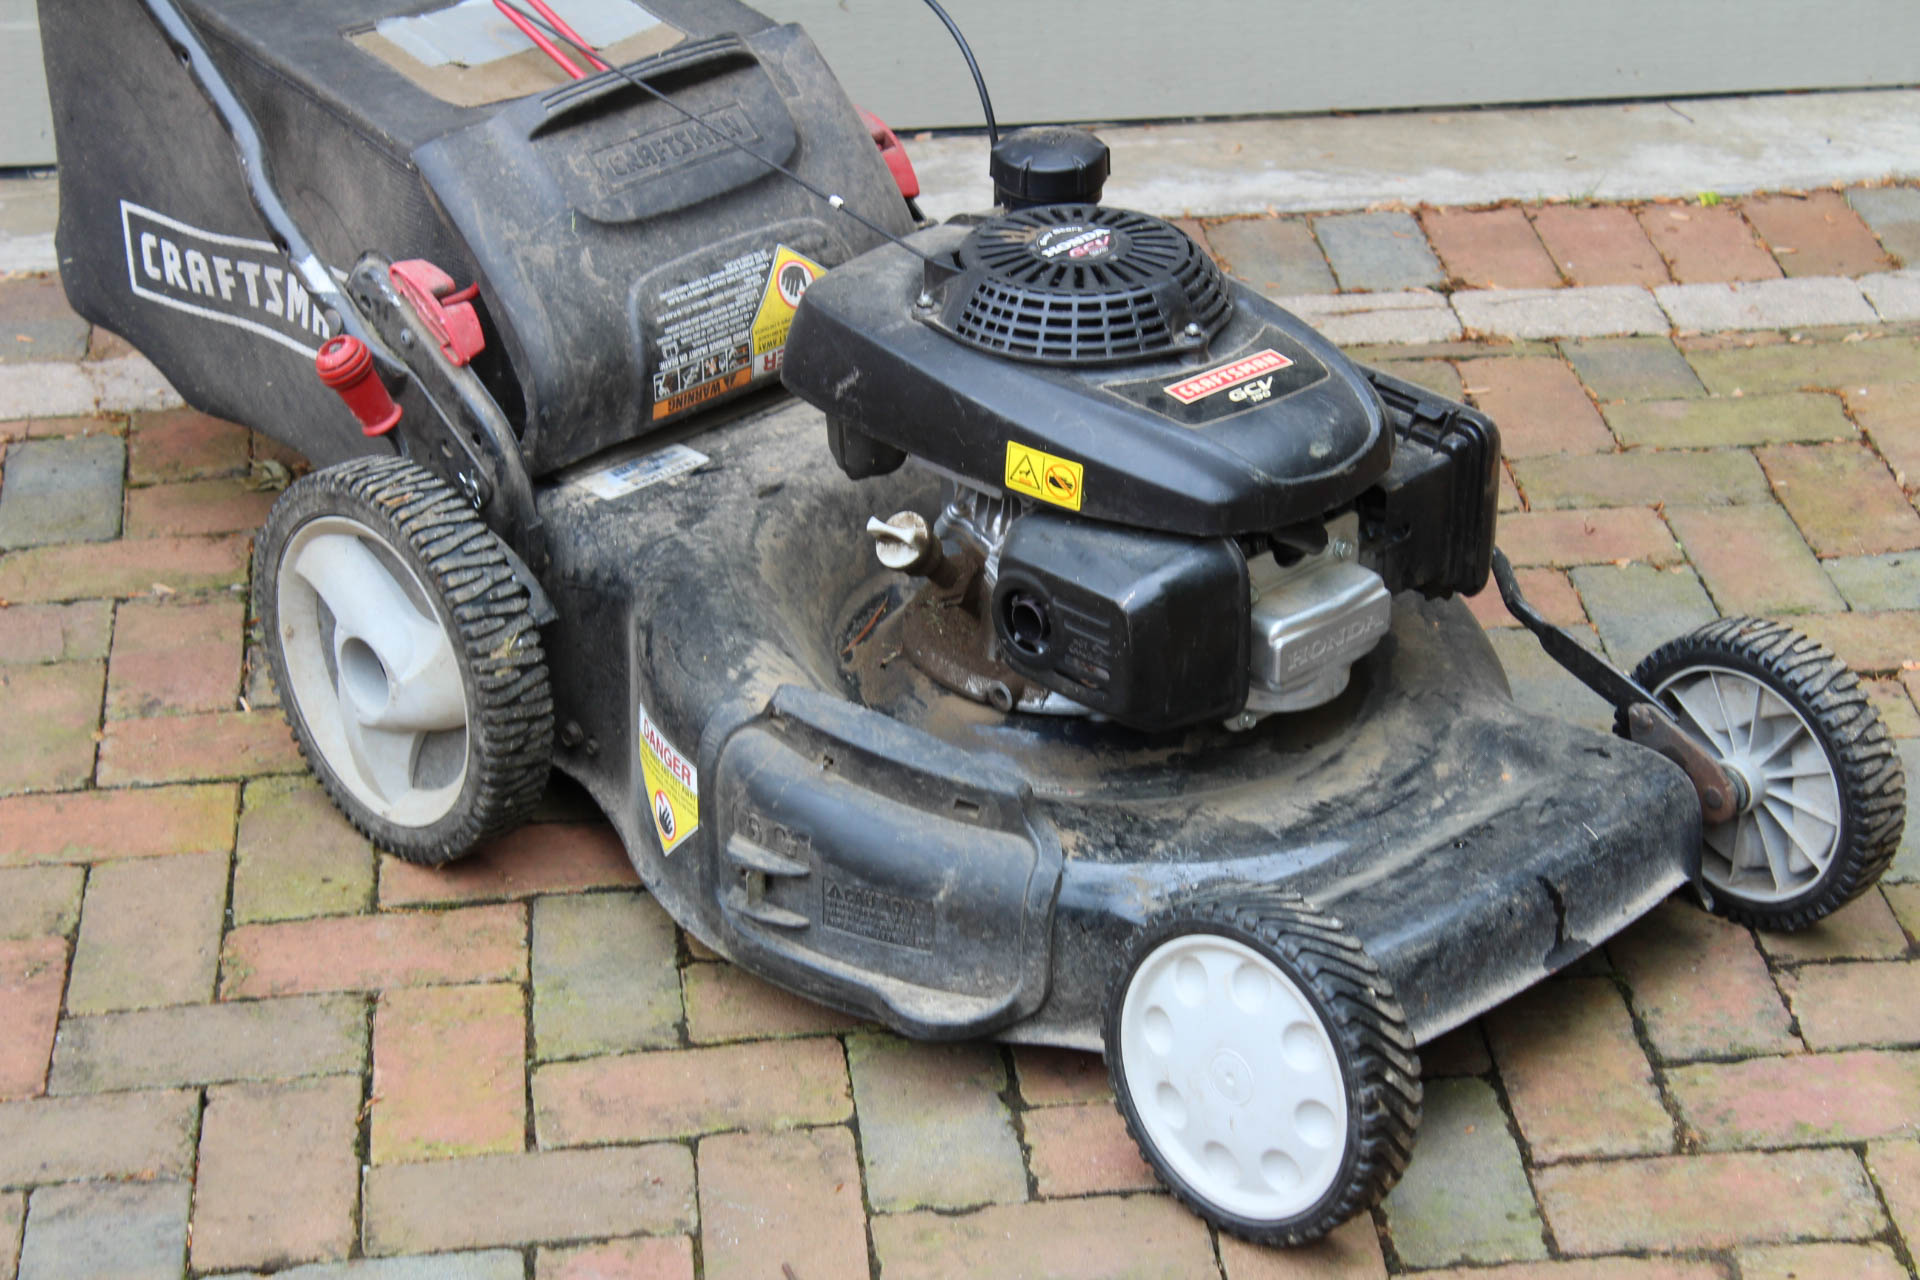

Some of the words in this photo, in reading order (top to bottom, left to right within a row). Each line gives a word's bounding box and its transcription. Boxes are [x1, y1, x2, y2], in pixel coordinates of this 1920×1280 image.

[607, 111, 744, 177] CRAFTSMAN
[1041, 228, 1111, 258] HONDA
[1068, 234, 1111, 257] GCV
[1178, 354, 1281, 398] CRAFTSMAN
[1228, 376, 1273, 402] GCV
[668, 380, 721, 412] WARNING
[1287, 615, 1385, 672] HONDA
[643, 717, 692, 787] DANGER
